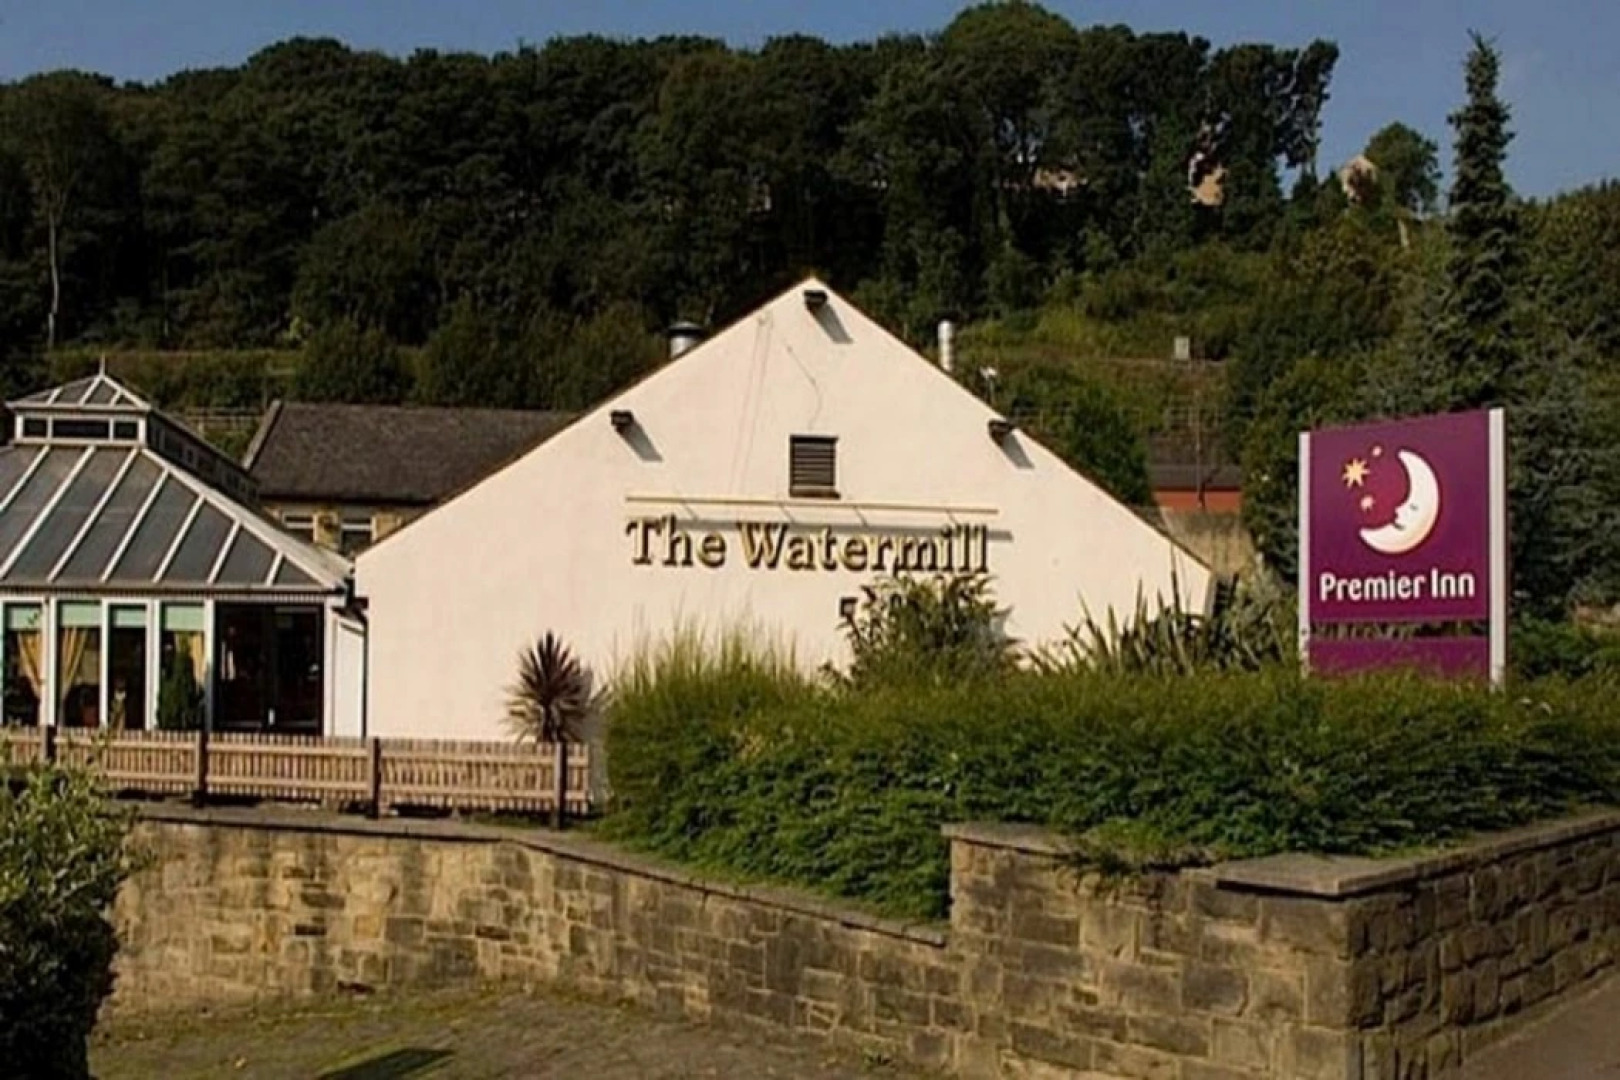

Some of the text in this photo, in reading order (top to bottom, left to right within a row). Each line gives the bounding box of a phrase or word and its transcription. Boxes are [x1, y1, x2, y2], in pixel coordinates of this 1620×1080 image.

[626, 515, 989, 573] The Watermill
[1319, 567, 1475, 601] Premier Inn
